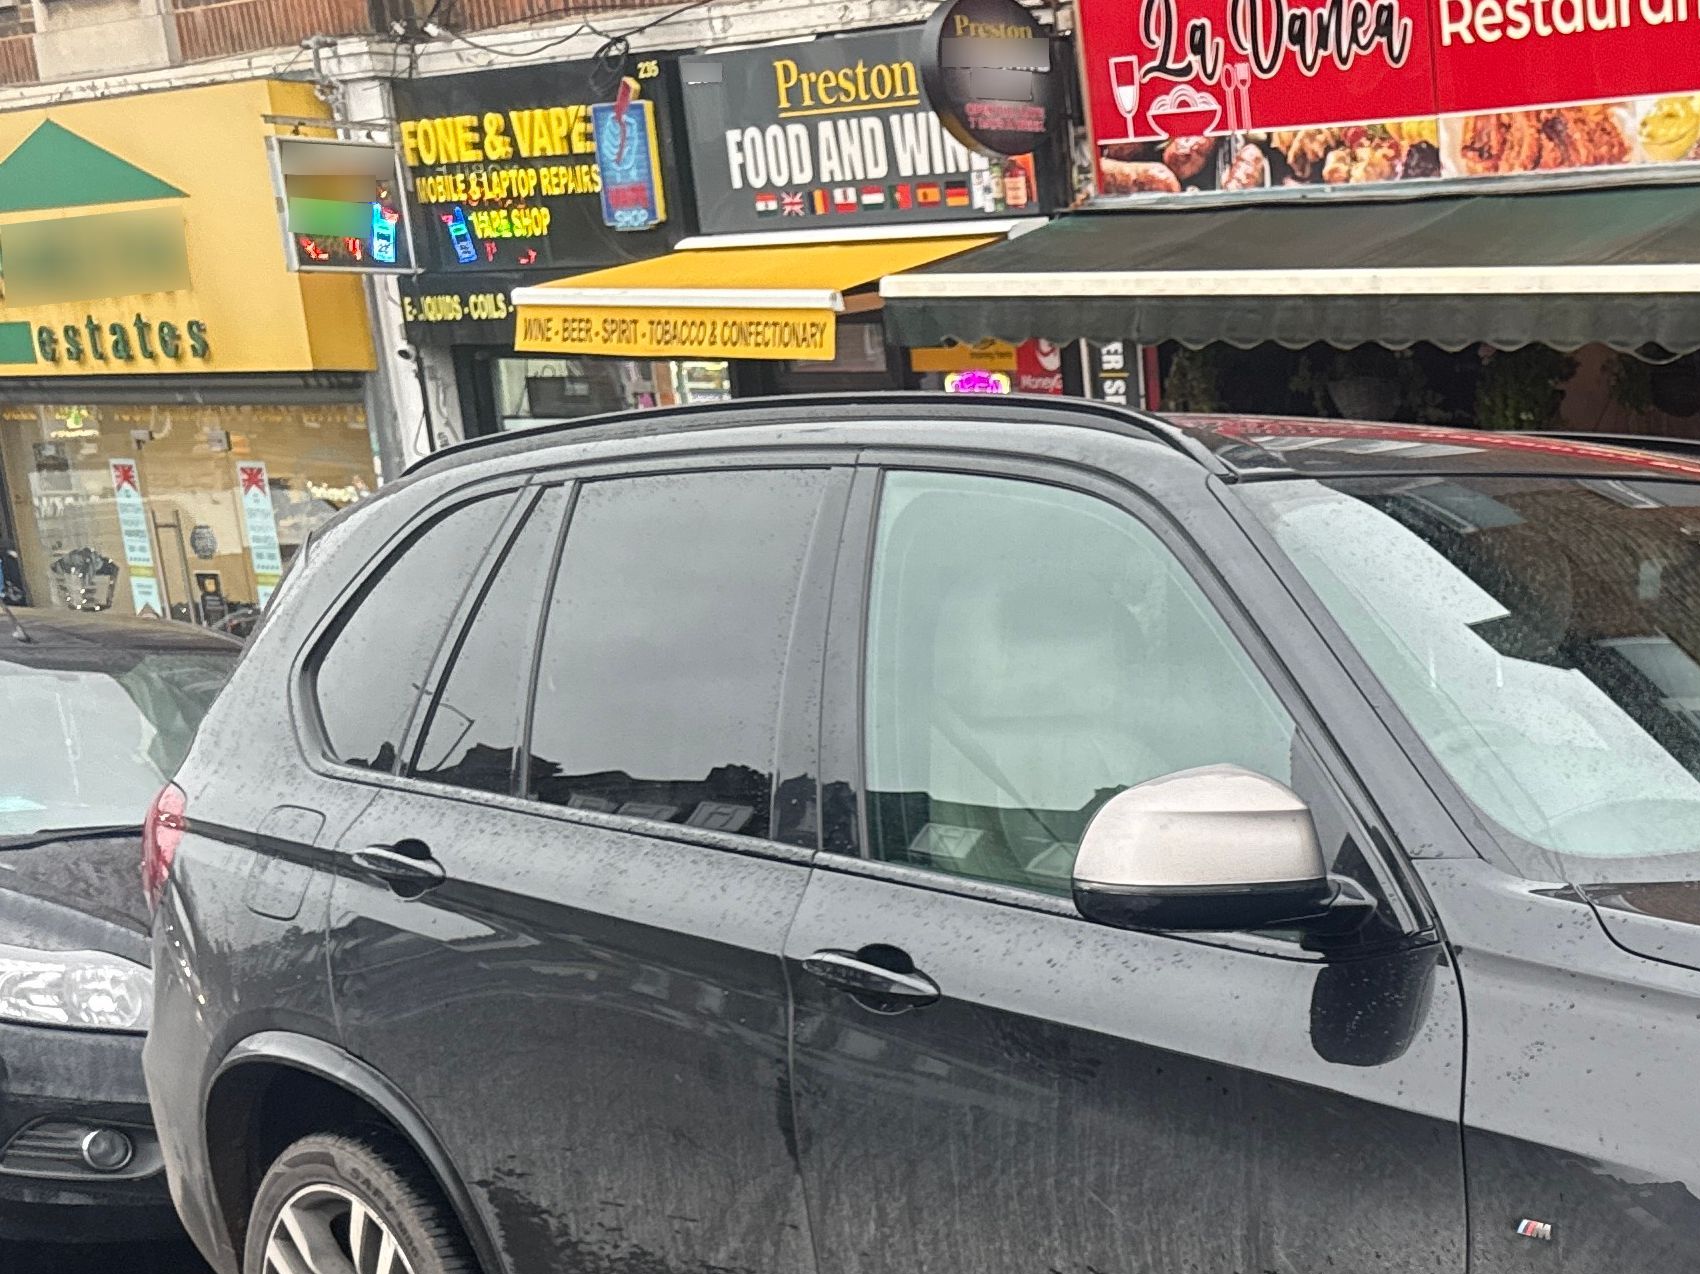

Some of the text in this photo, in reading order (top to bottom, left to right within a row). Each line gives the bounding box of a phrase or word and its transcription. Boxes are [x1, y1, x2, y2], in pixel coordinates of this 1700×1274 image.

[953, 13, 1034, 39] Preston
[1140, 0, 1222, 83] La
[772, 58, 919, 109] Preston
[400, 104, 597, 167] FONE & VAPE
[725, 123, 814, 190] FOOD
[817, 116, 889, 183] AND
[415, 172, 468, 204] MOBILE
[468, 171, 482, 201] &
[482, 167, 538, 200] LAPTOP
[539, 163, 602, 196] REPAIRS
[511, 206, 551, 238] SHOP
[37, 312, 210, 364] estates
[523, 316, 827, 349] WINE BEER SPIRIT TOBACCO & CONFECTIONARY
